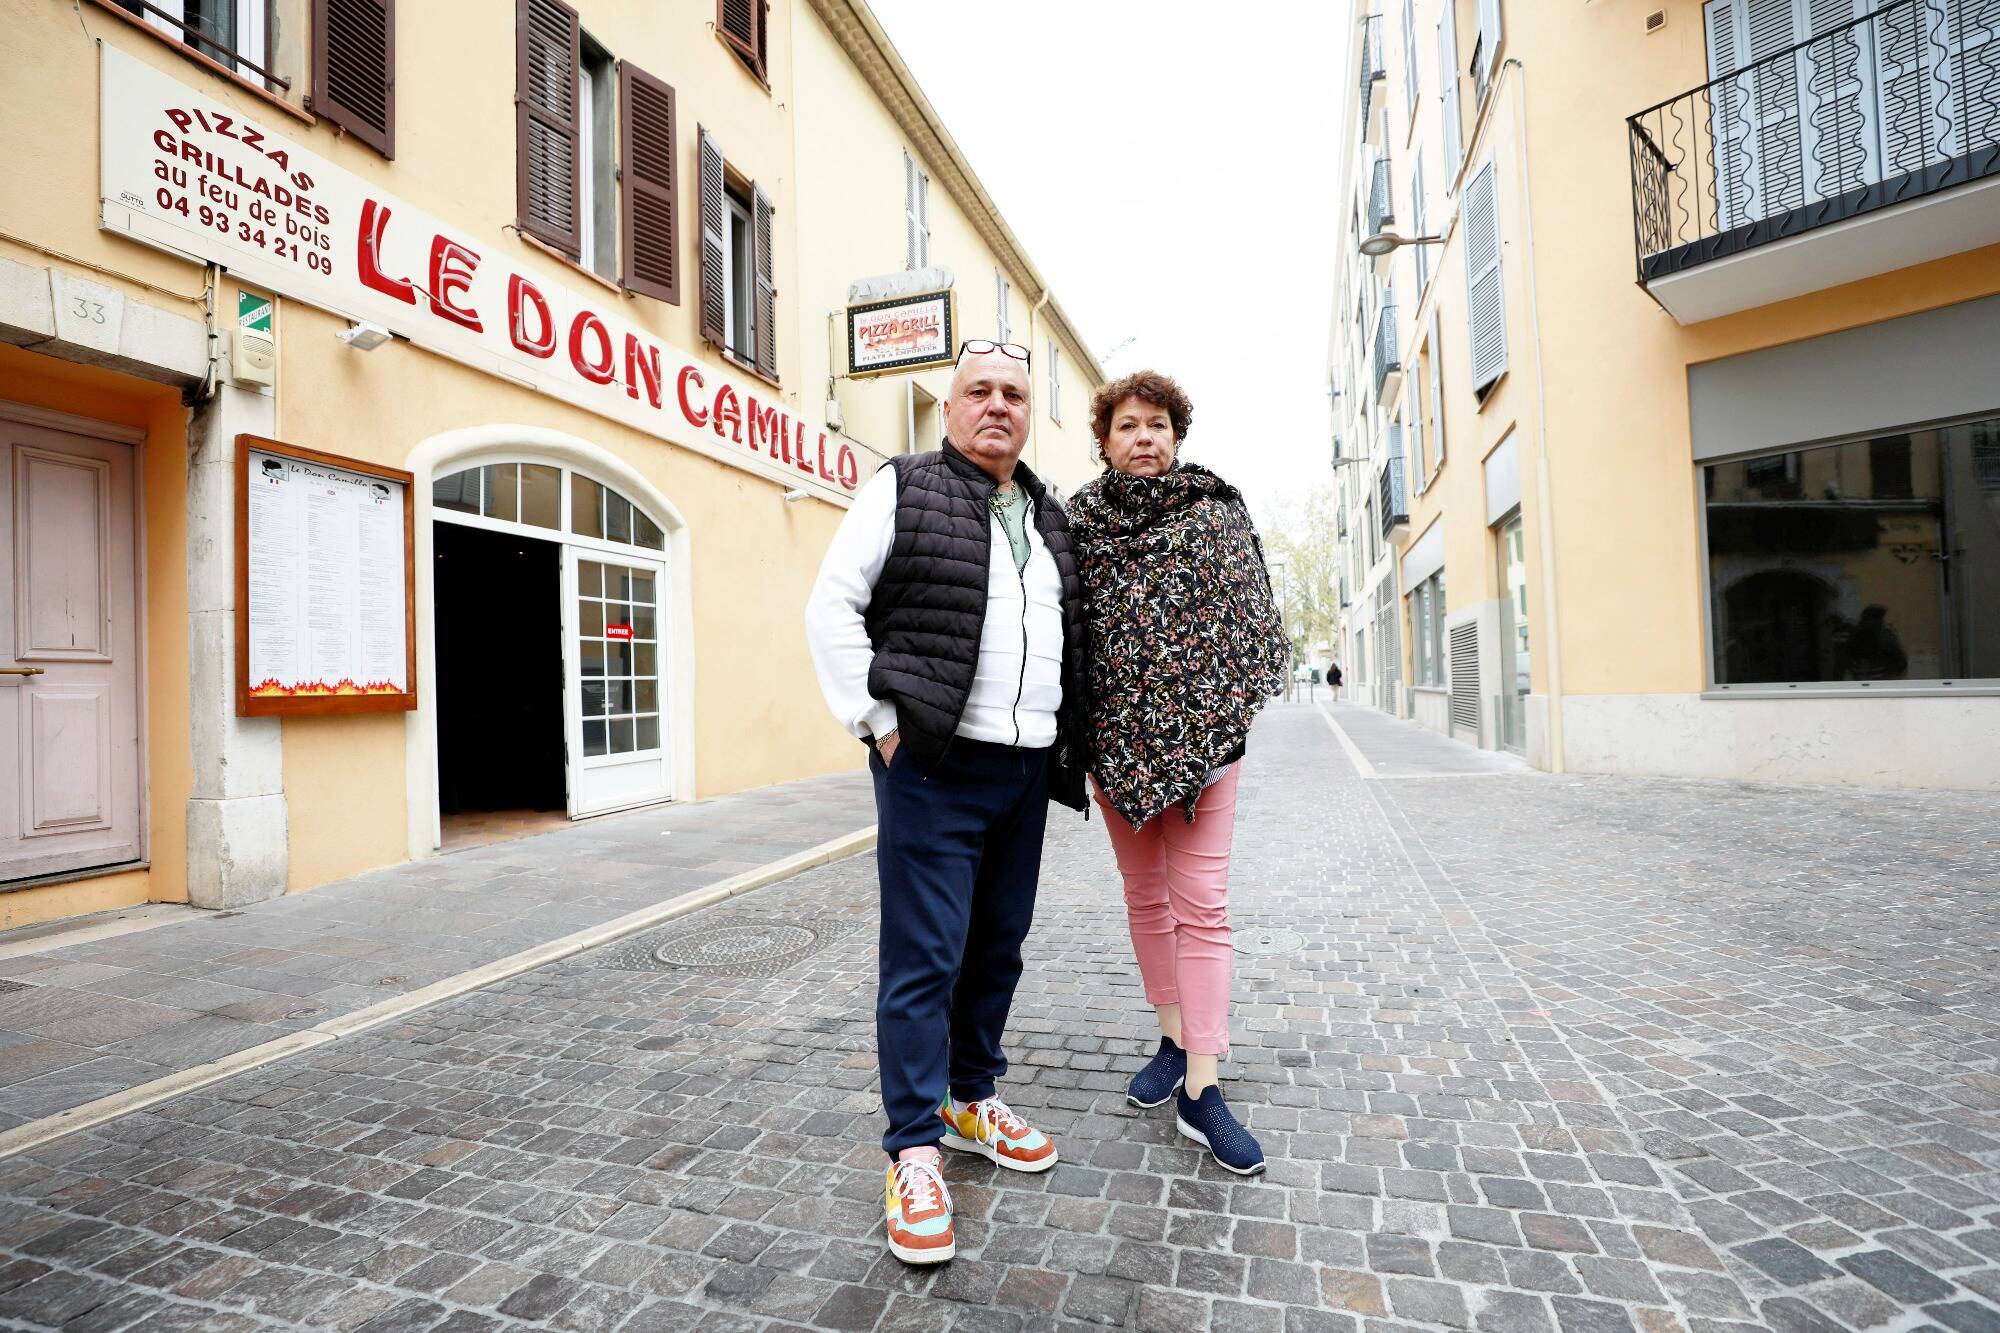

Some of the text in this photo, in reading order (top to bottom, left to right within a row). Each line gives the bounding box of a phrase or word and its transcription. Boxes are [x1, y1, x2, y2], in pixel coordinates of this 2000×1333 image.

[153, 129, 330, 225] GRILLADES
[164, 108, 315, 192] PIZZAS
[154, 159, 331, 251] au feu de bois
[156, 187, 190, 218] 04
[199, 205, 230, 233] 93
[238, 221, 266, 249] 34
[274, 237, 298, 262] 21
[307, 251, 332, 276] 09
[72, 297, 105, 325] 33
[358, 198, 858, 490] LE DON CAMILLO
[859, 314, 940, 339] PIZZA GRILL
[304, 467, 325, 478] Don
[328, 473, 368, 487] Camillo
